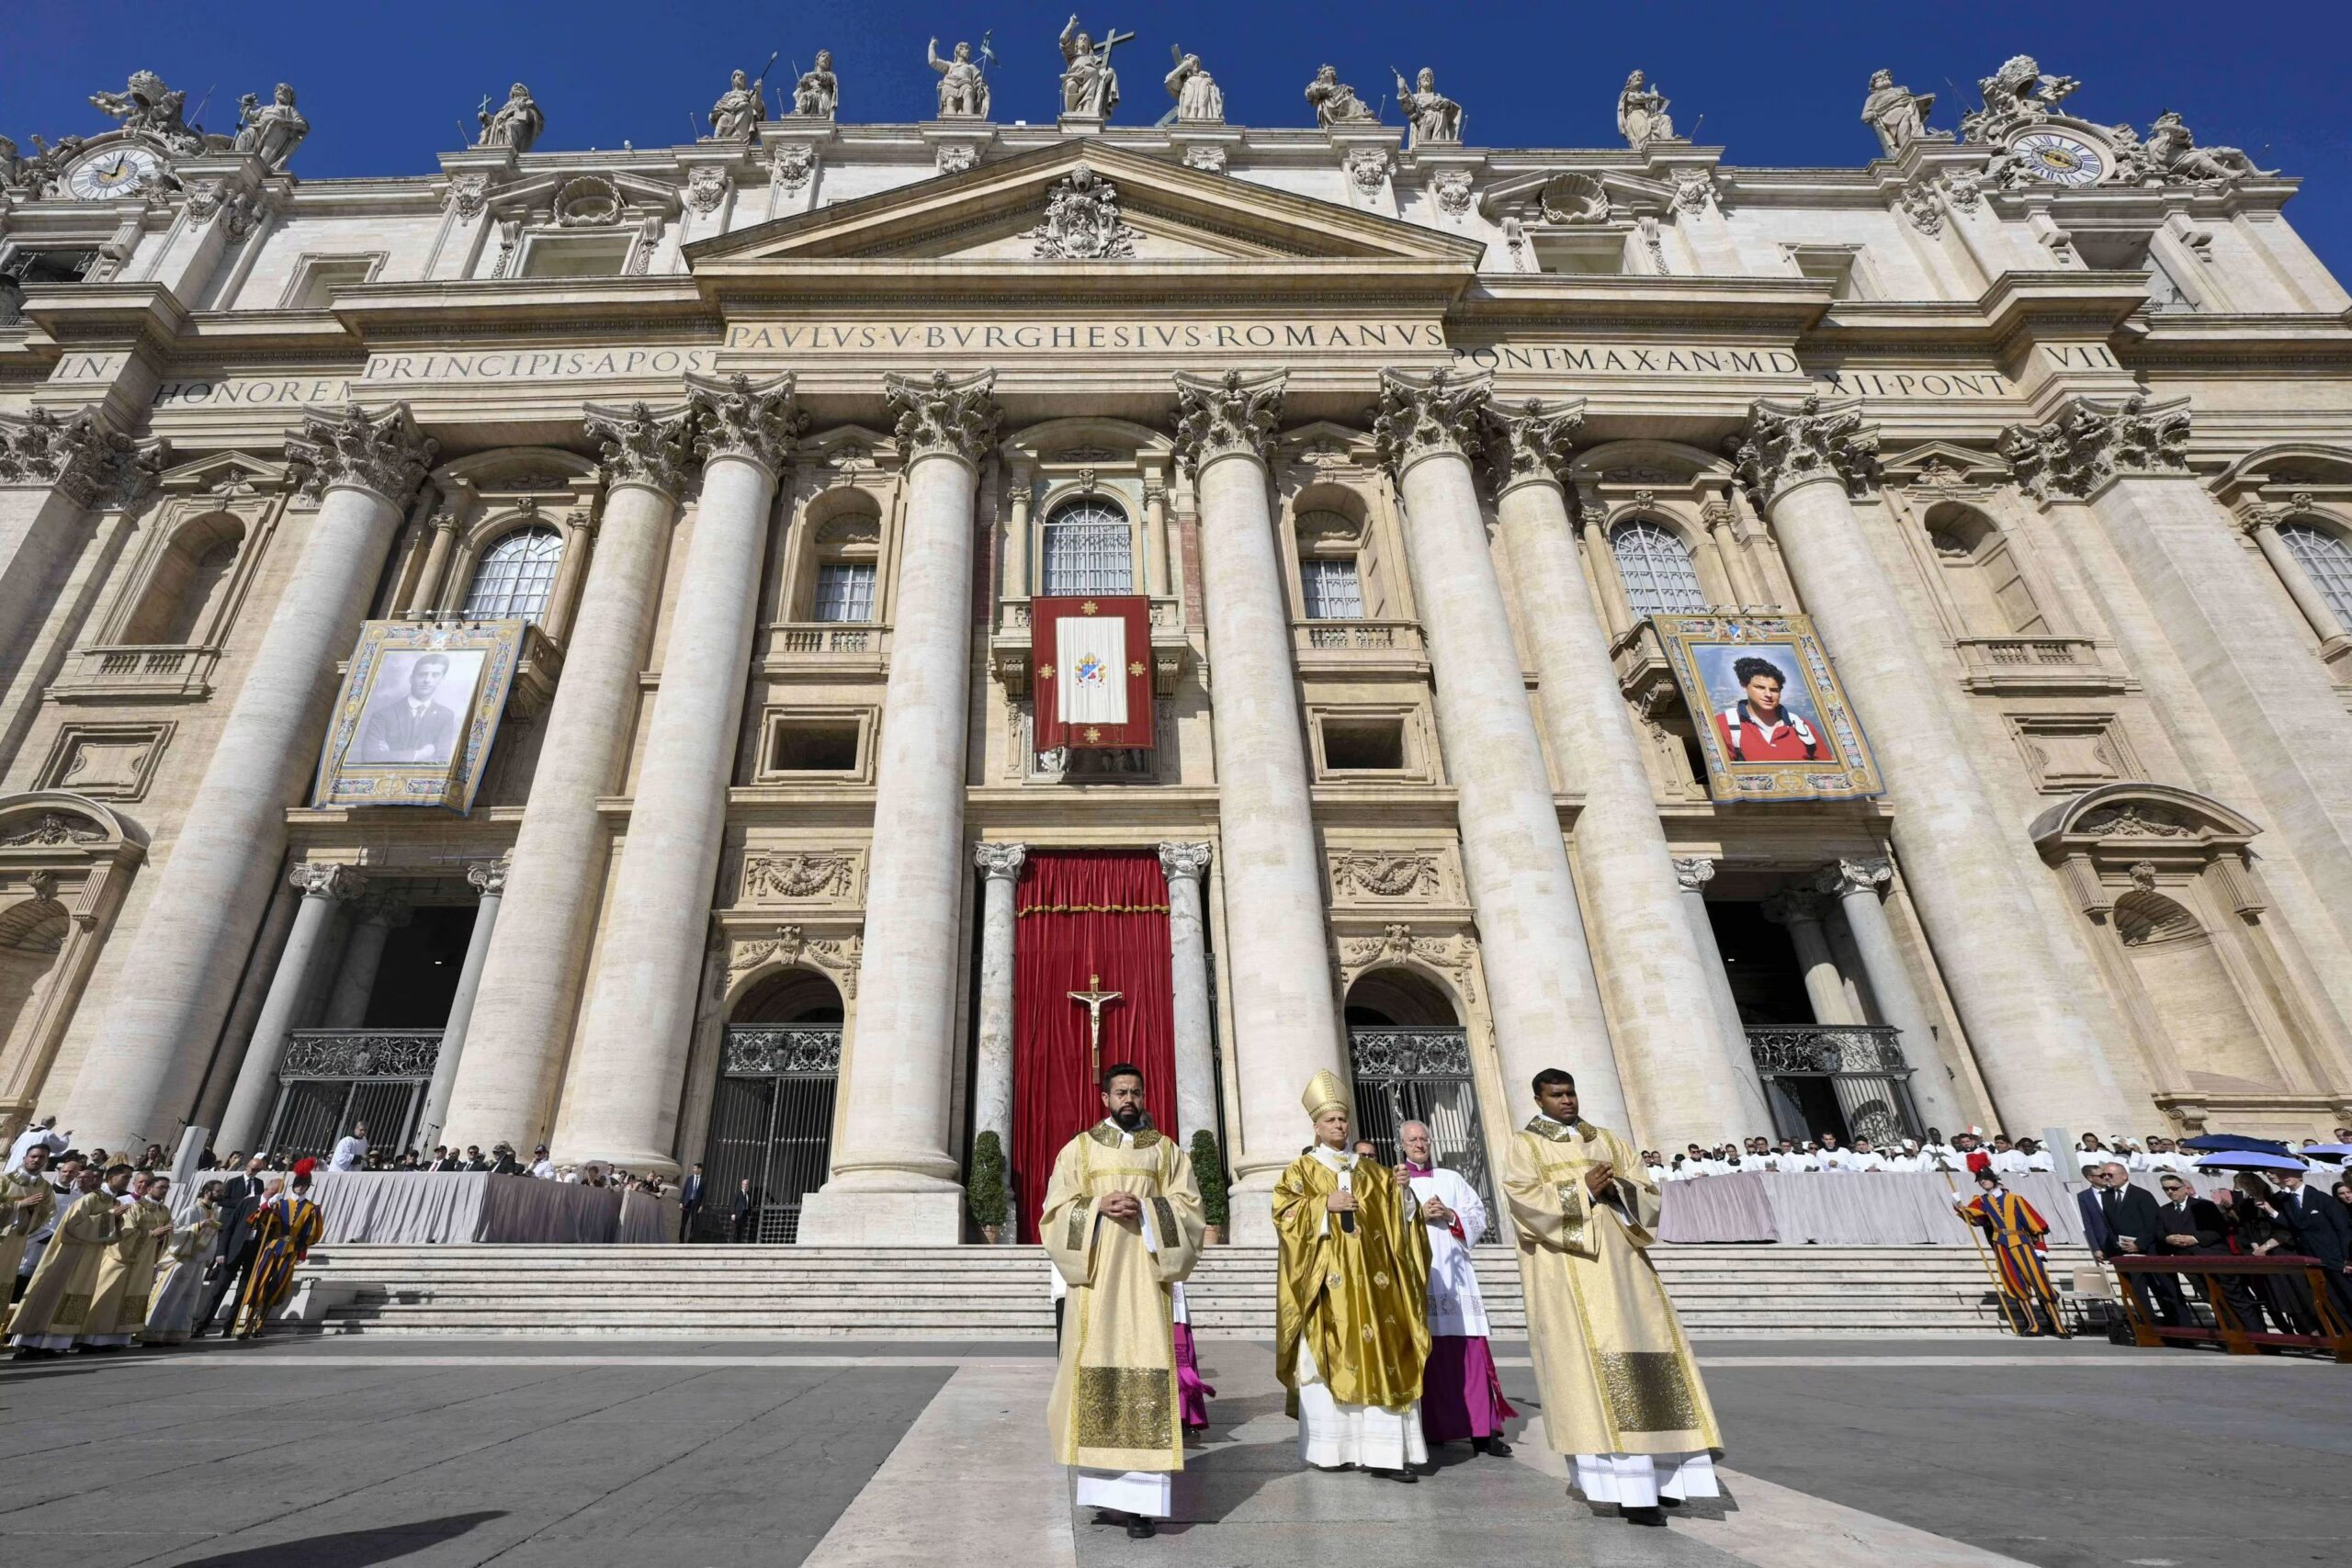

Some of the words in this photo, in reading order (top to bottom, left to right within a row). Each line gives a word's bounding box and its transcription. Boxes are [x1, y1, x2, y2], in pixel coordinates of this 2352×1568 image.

[53, 356, 115, 378] IN
[364, 352, 584, 379] PRINCIPIS
[593, 349, 723, 374] APOST
[729, 325, 875, 348] PAVLVS
[886, 325, 912, 348] V
[925, 325, 1209, 348] BVRGHESIVS
[1215, 324, 1443, 347] ROMANVS
[1562, 348, 1655, 371] MAX
[1658, 350, 1719, 372] AN
[1821, 374, 1890, 395] XII
[1894, 374, 2005, 396] PONT
[2041, 346, 2116, 368] VII
